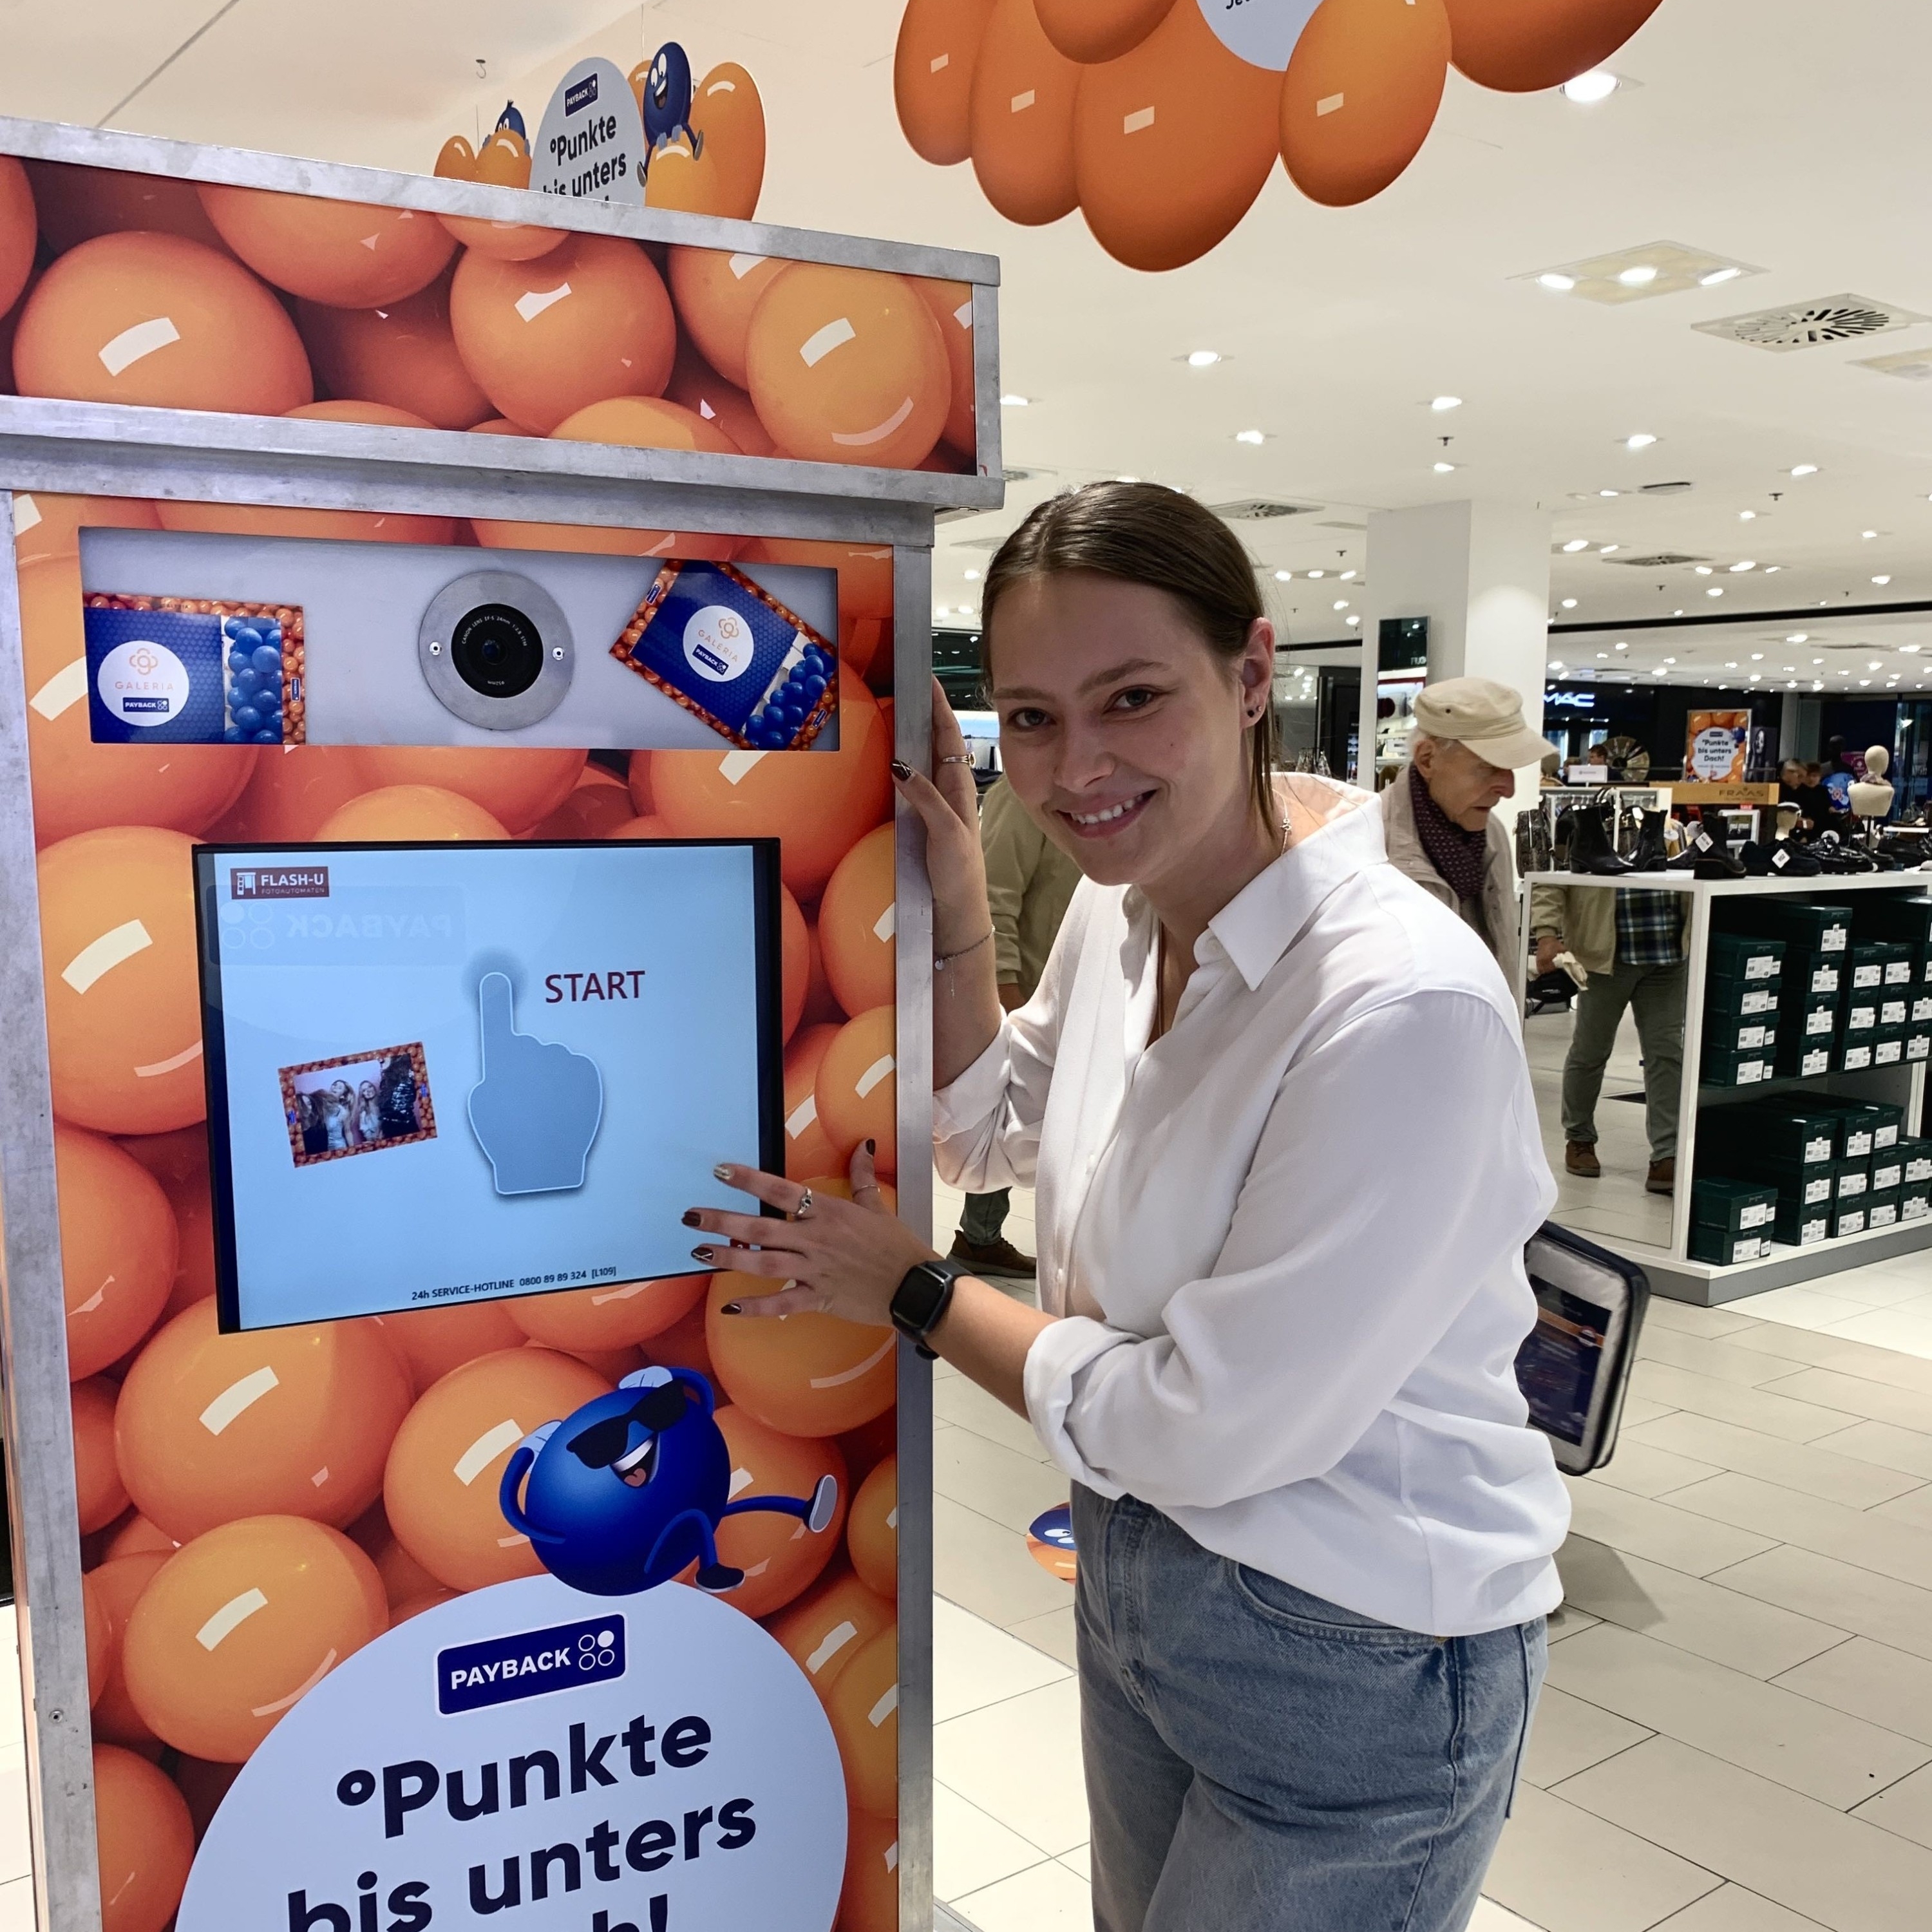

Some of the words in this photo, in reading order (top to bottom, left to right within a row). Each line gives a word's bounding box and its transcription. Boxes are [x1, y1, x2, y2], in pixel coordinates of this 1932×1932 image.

[567, 88, 588, 107] PAYBACK
[572, 153, 626, 197] unters
[462, 627, 471, 644] CANON
[472, 618, 482, 627] LENS
[698, 630, 738, 662] GALERIA
[696, 649, 719, 667] PAYBACK
[115, 681, 173, 691] GALERIA
[261, 873, 324, 886] FLASH-U
[545, 971, 645, 1003] START
[412, 1287, 430, 1300] 24h
[431, 1279, 515, 1298] SERVICE-HOTLINE
[519, 1276, 542, 1287] 0800
[544, 1274, 554, 1283] 89
[557, 1272, 568, 1282] 89
[571, 1270, 587, 1281] 324
[450, 1647, 571, 1690] PAYBACK
[469, 1797, 756, 1916] unters
